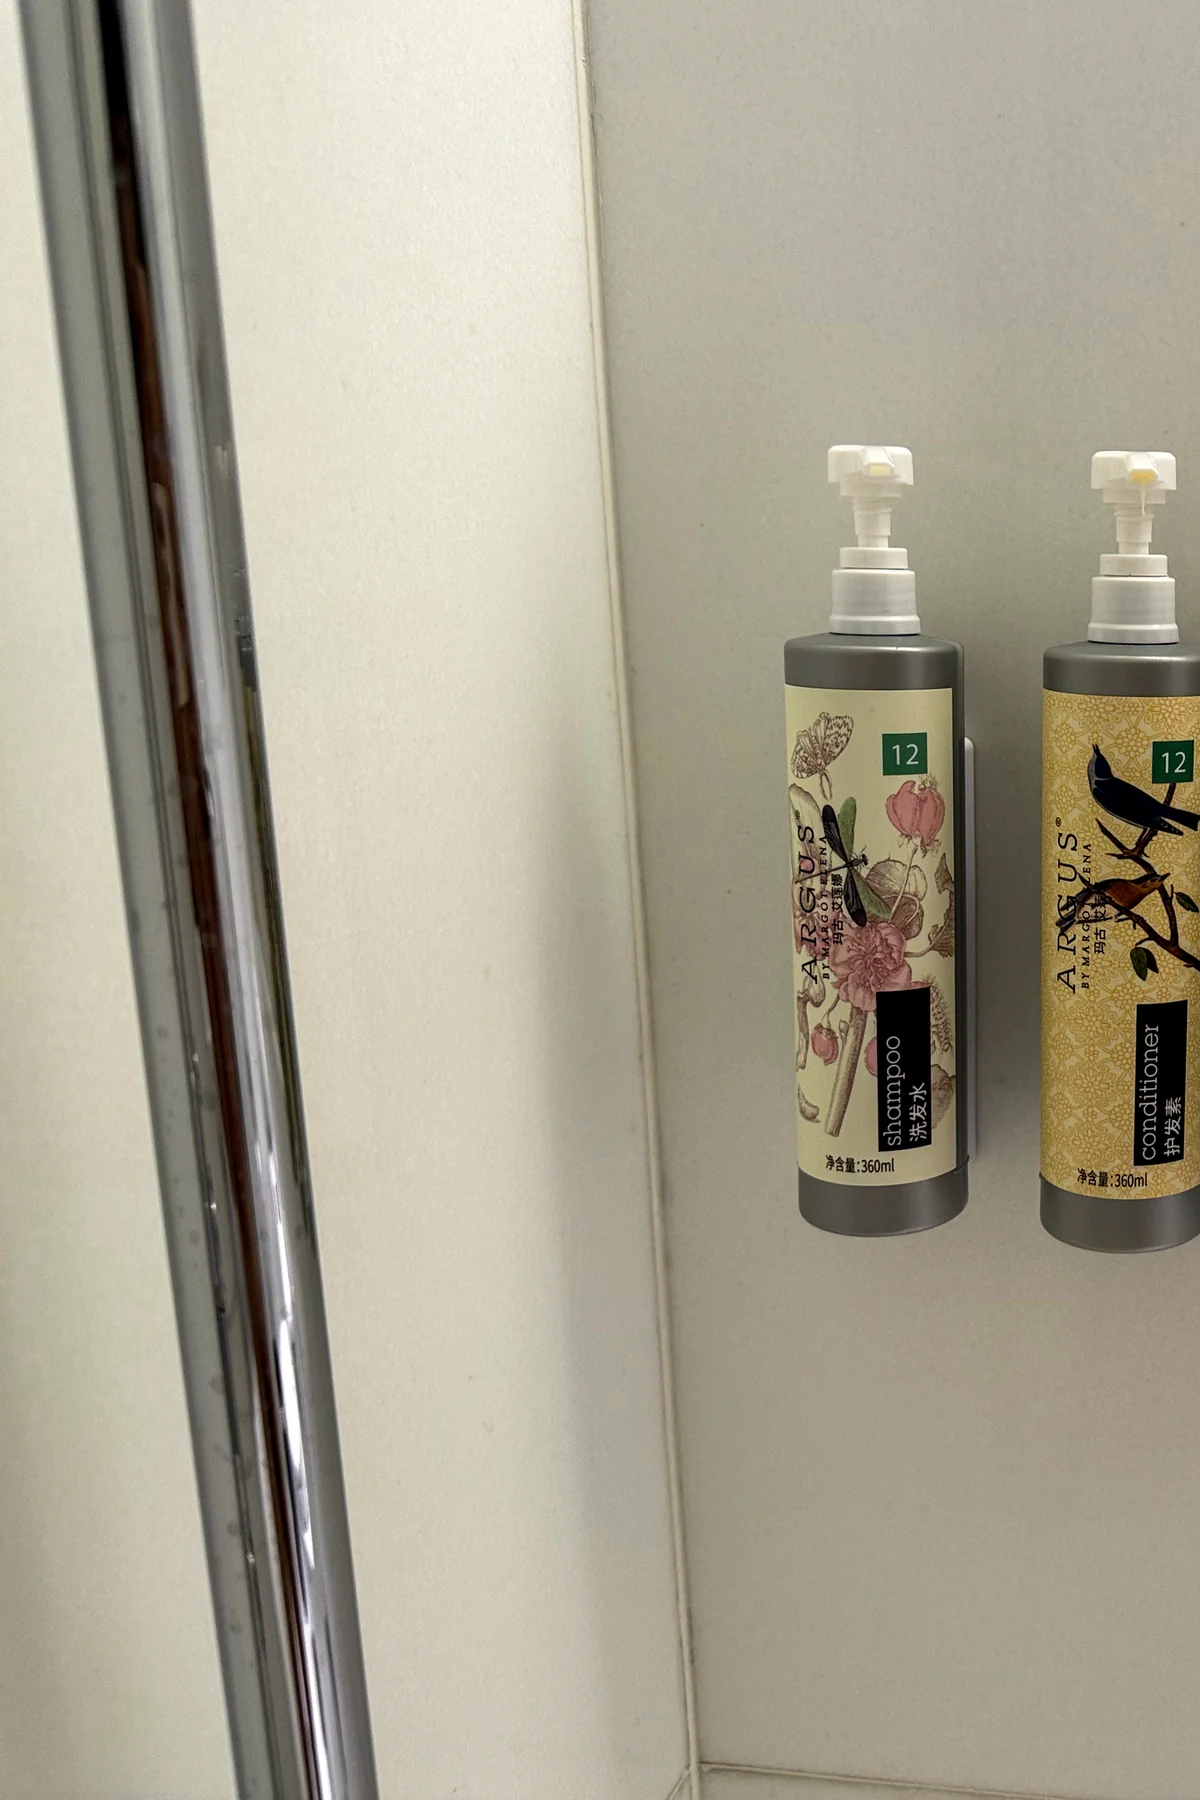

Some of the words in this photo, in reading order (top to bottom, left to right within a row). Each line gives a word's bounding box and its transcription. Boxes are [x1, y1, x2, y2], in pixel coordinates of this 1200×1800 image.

[892, 743, 919, 766] 12
[1161, 751, 1187, 773] 12
[819, 835, 828, 886] ELENA
[820, 891, 830, 958] MARGOT
[831, 918, 845, 946] 玛古
[1093, 927, 1107, 955] 玛古
[822, 962, 830, 980] BY
[1081, 972, 1090, 990] BY
[883, 1035, 906, 1147] shampoo
[1138, 1023, 1159, 1161] conditioner
[909, 1082, 928, 1142] 洗发水
[1163, 1096, 1182, 1157] 护发素
